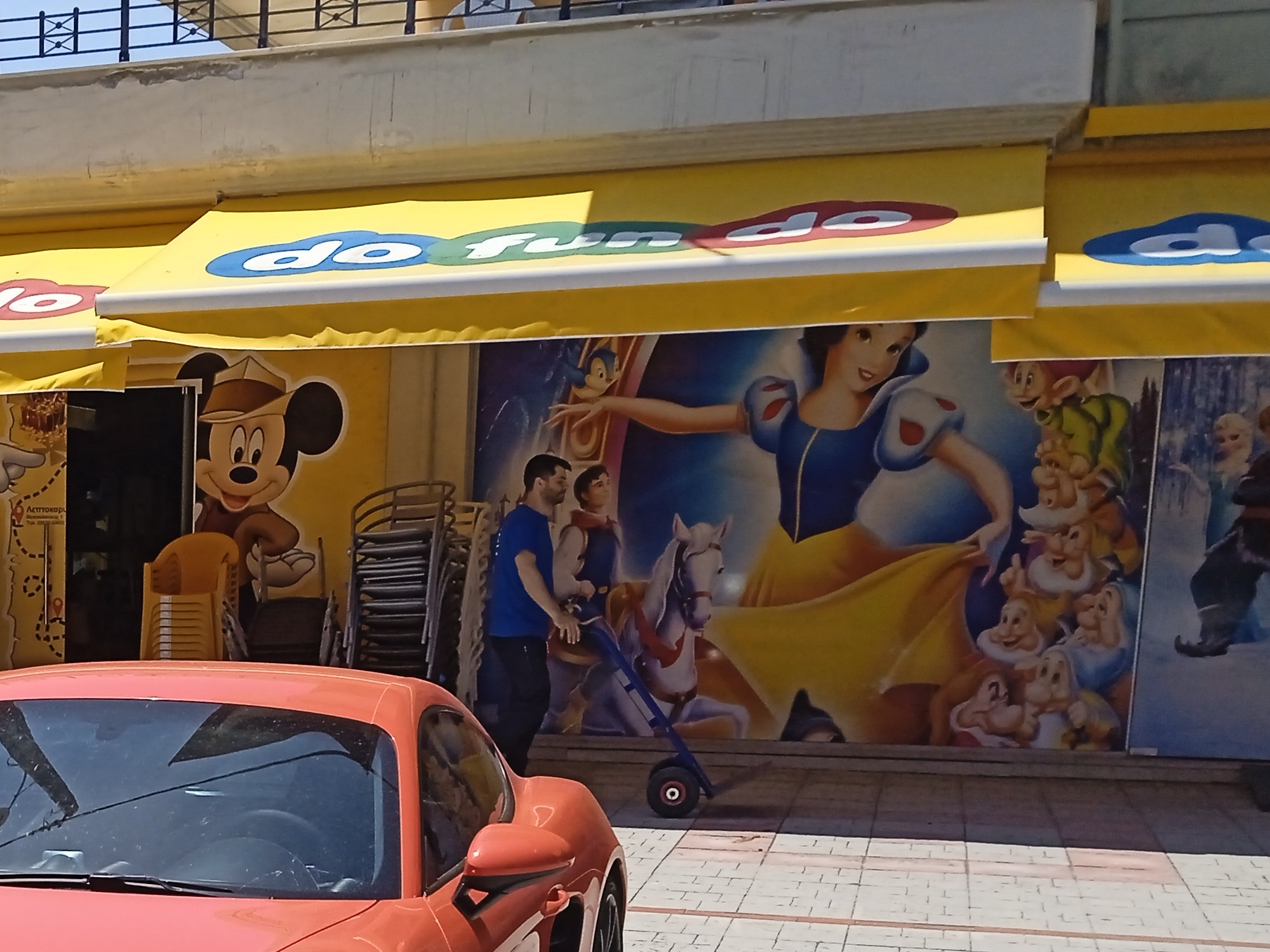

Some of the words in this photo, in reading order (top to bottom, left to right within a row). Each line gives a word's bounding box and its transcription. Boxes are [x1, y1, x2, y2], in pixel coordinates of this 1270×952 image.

[243, 240, 421, 272] do
[466, 230, 682, 260] fun
[726, 210, 912, 242] do
[1130, 224, 1270, 258] d
